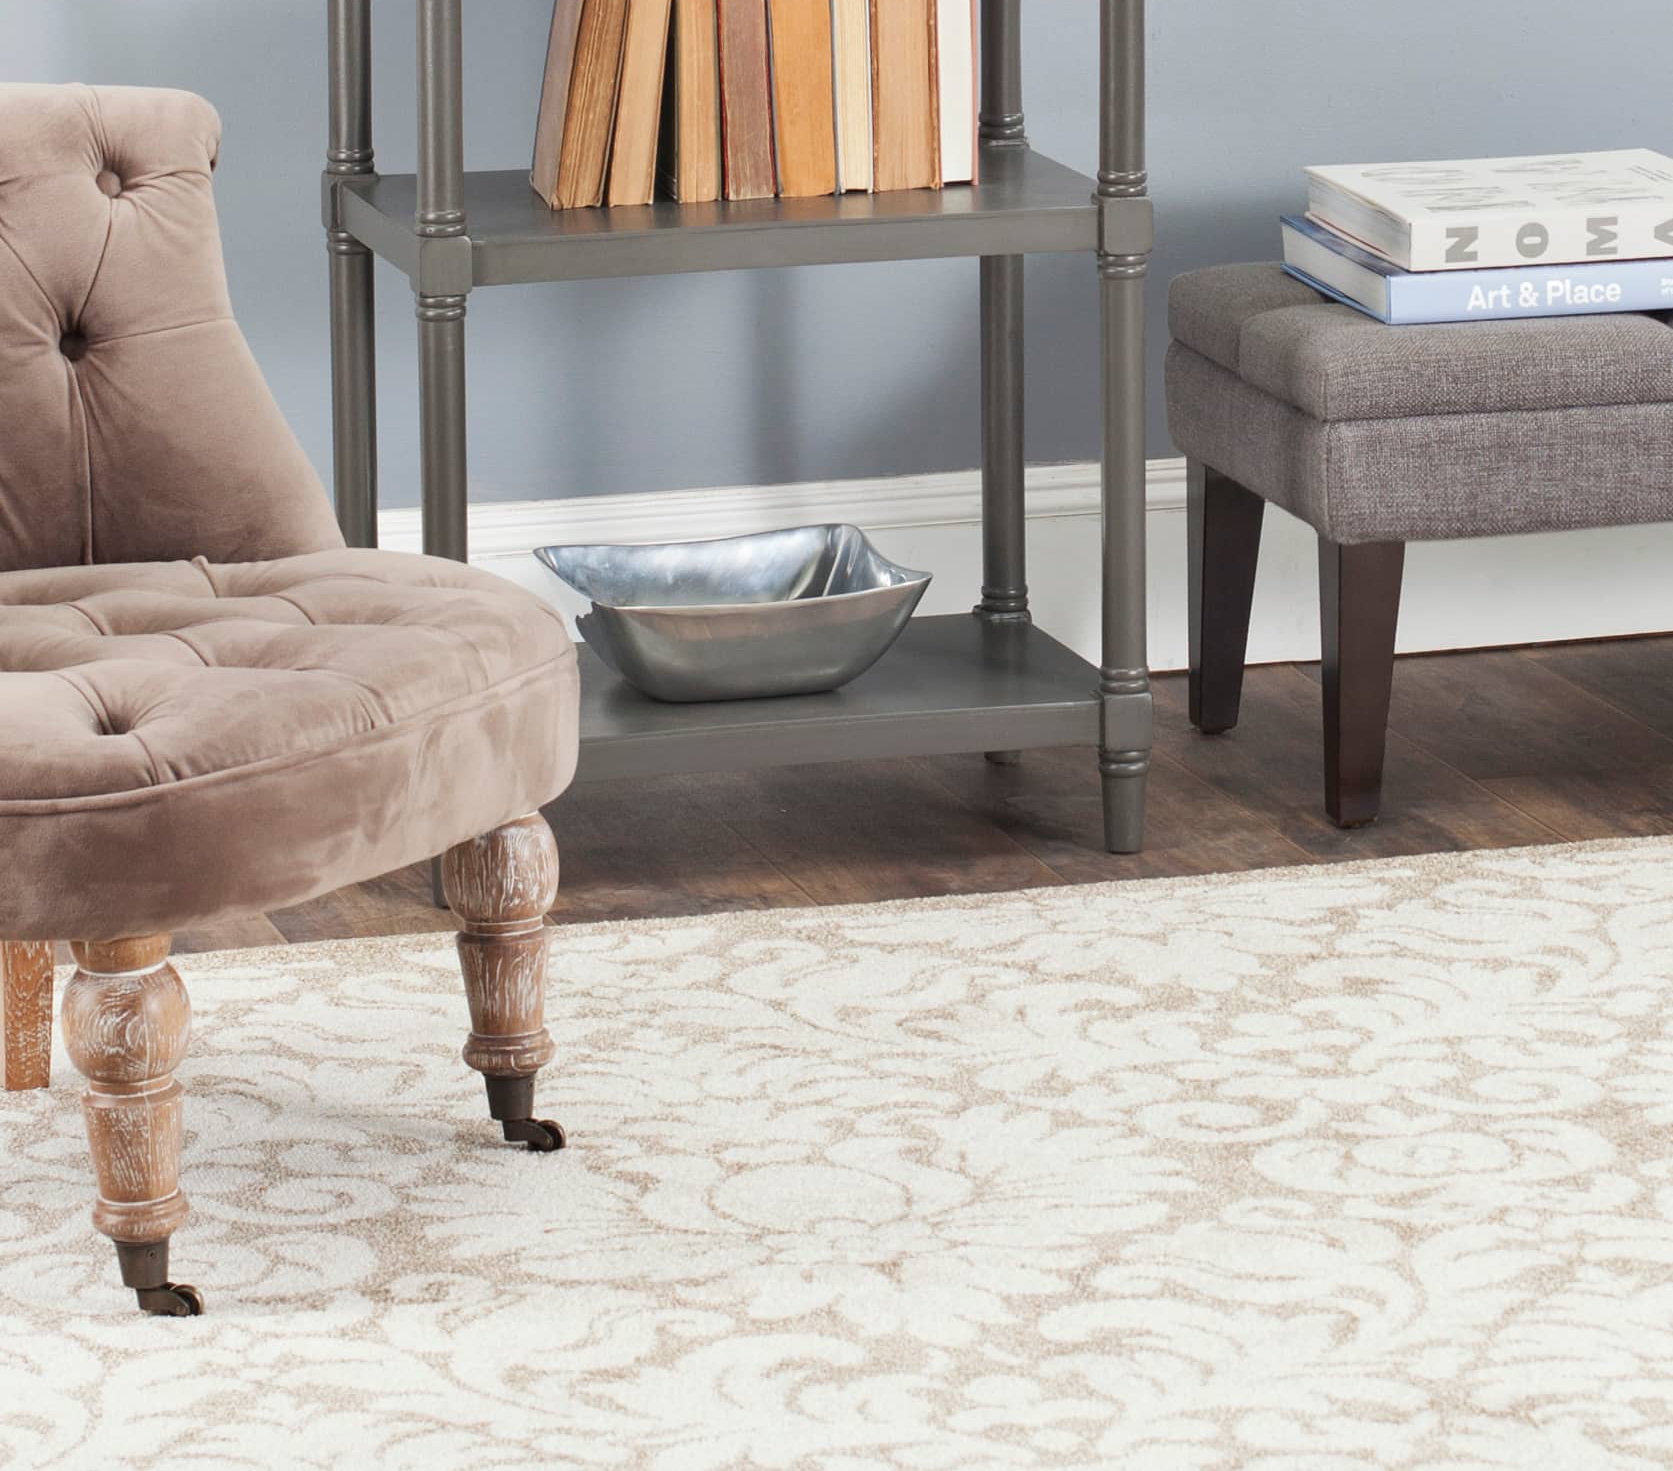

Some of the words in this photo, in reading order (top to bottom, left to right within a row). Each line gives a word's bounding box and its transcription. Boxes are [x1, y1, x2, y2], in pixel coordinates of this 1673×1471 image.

[1467, 285, 1512, 311] Art
[1518, 281, 1539, 307] &
[1547, 279, 1622, 306] Place
